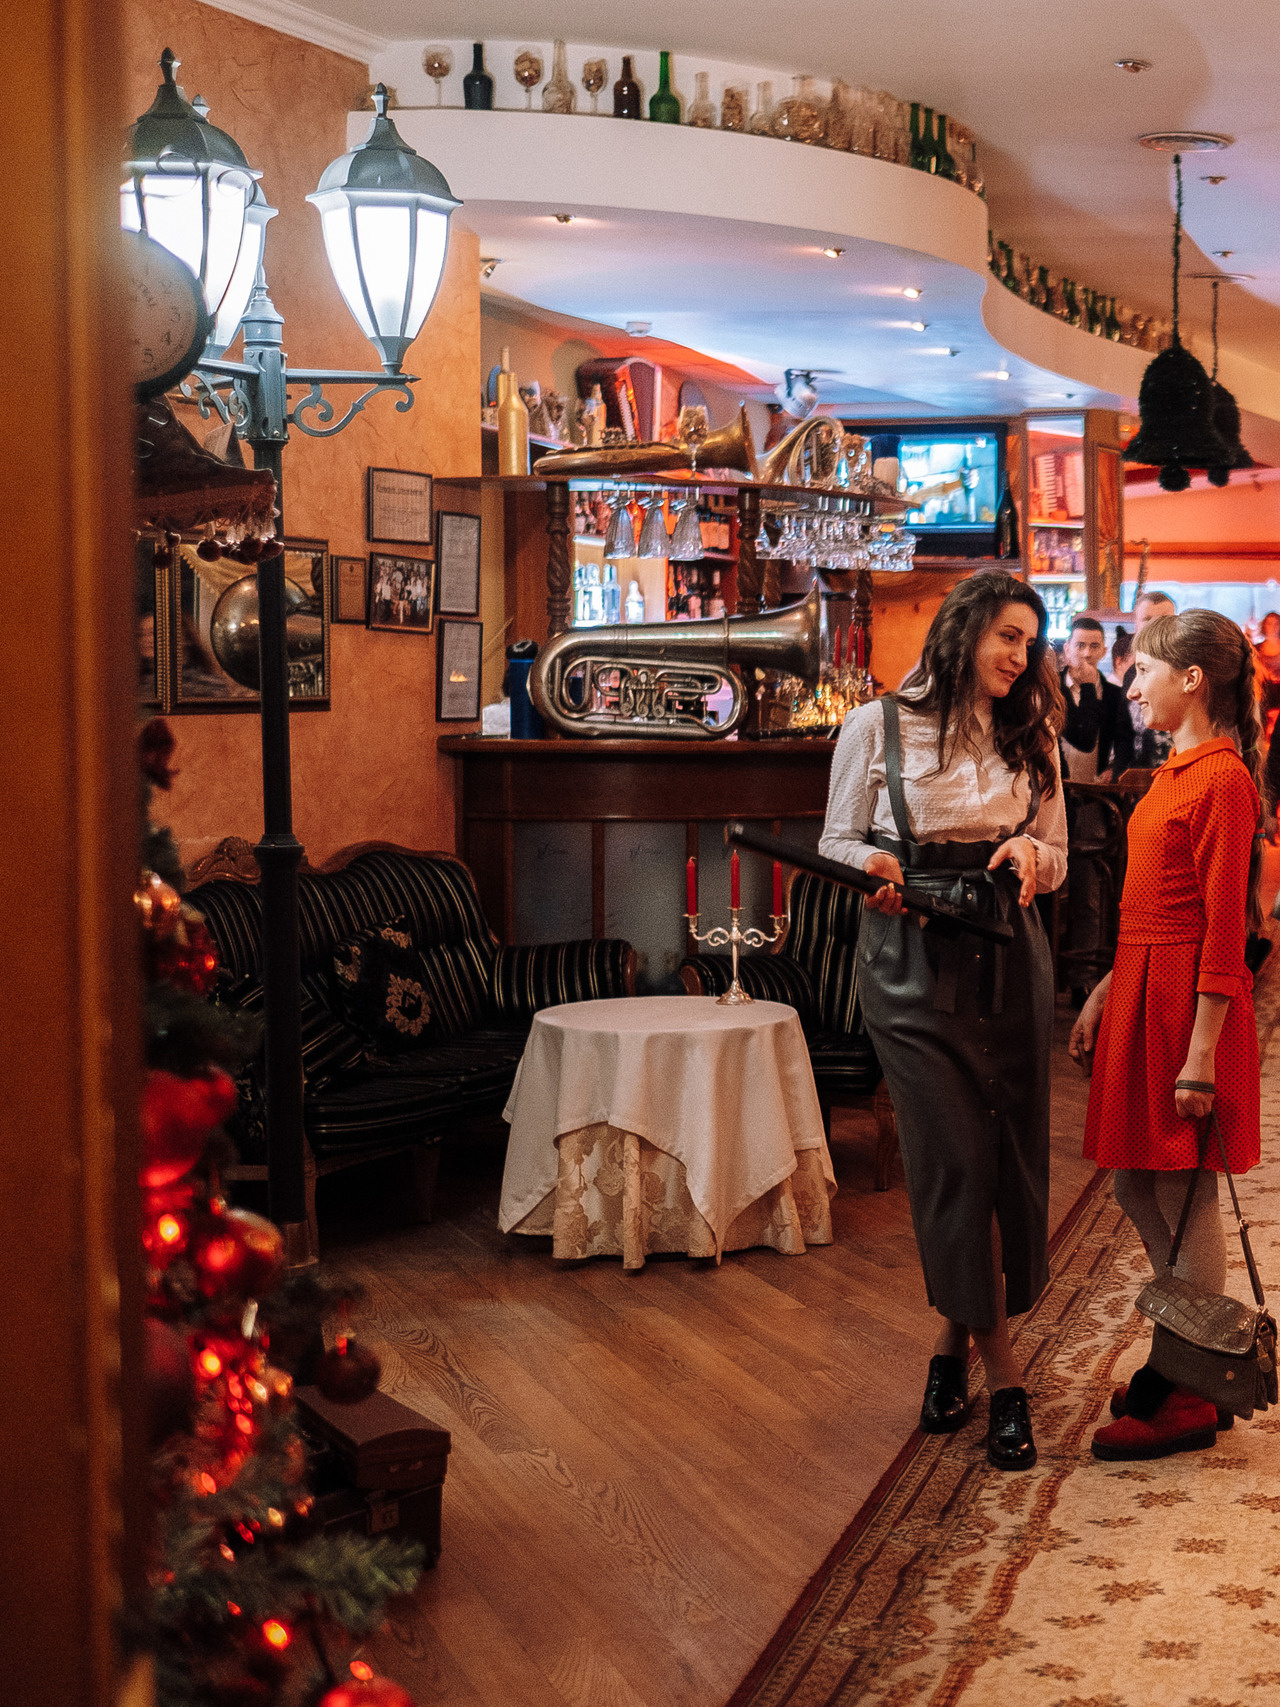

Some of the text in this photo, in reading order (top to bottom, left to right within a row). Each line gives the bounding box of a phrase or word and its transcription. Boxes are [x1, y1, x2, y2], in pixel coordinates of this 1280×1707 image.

[169, 305, 182, 324] 3
[161, 329, 173, 346] 4
[142, 347, 155, 364] 5
